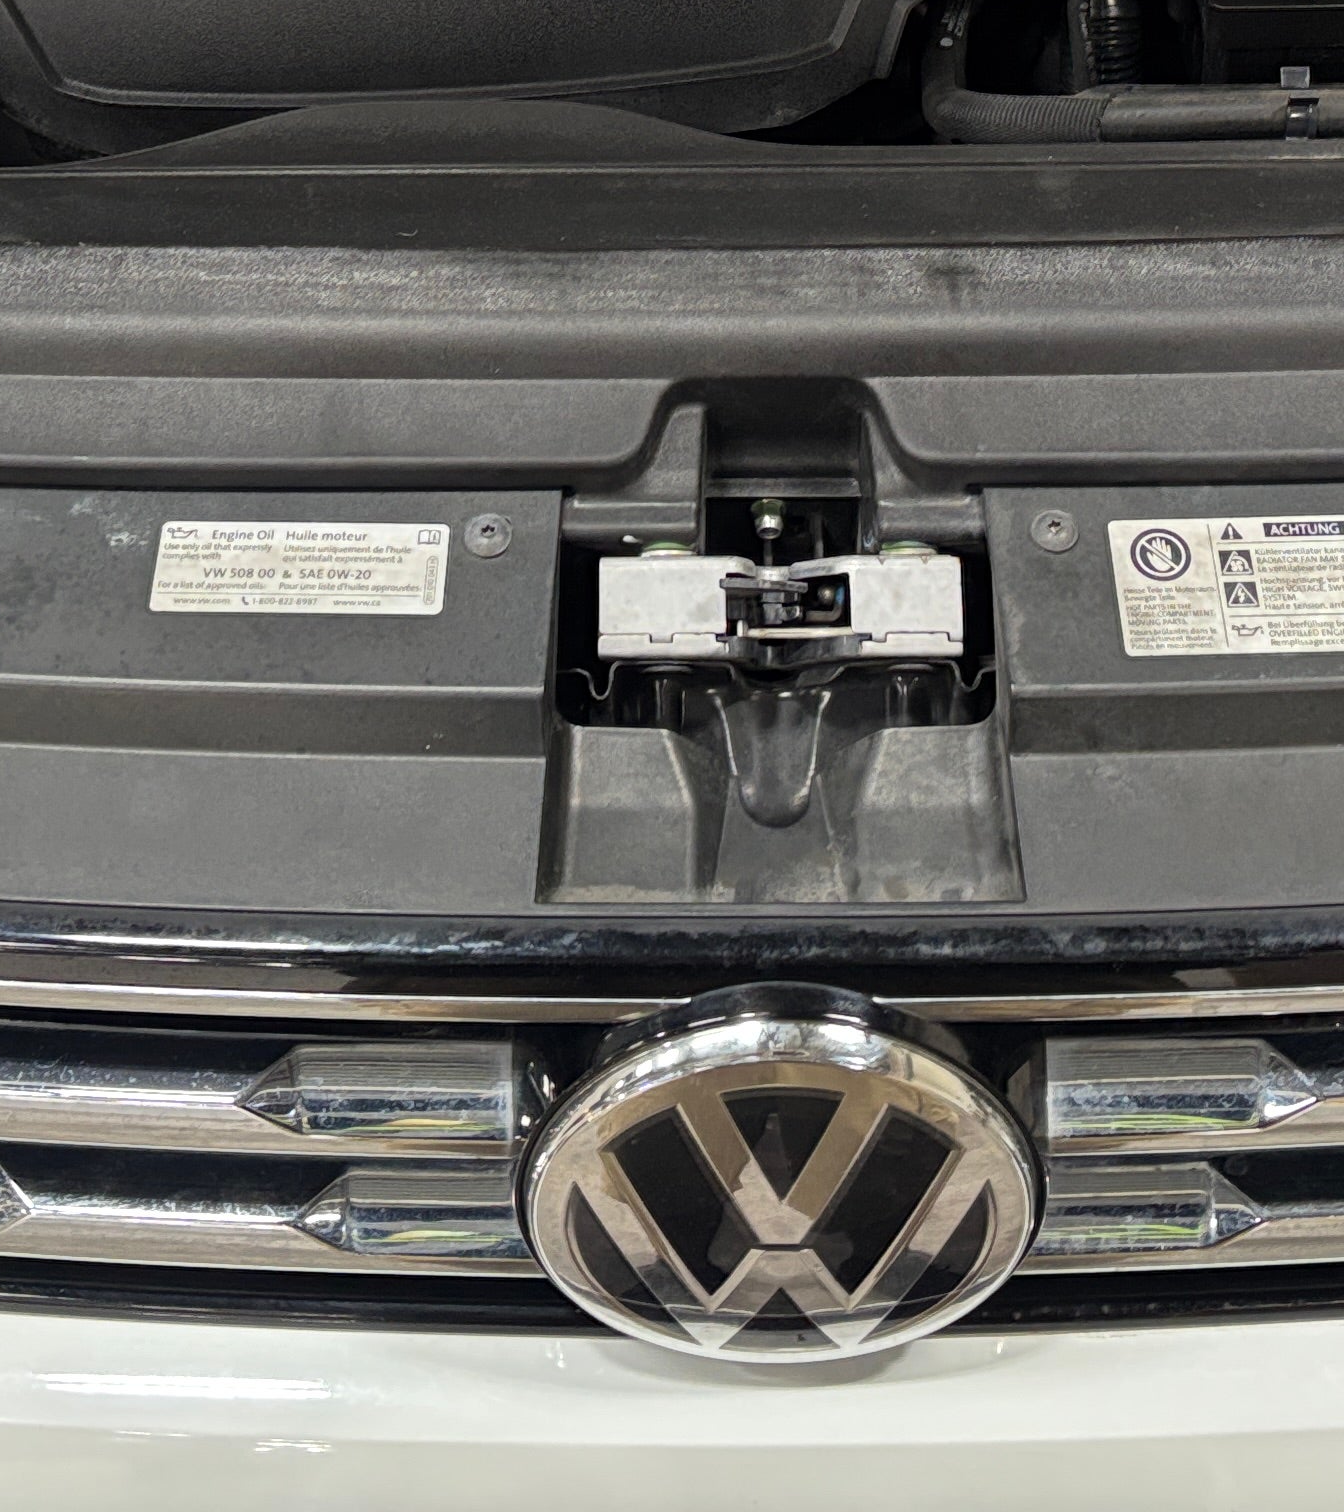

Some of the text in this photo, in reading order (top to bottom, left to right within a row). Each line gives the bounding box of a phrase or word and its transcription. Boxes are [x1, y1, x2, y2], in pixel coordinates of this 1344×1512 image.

[1269, 523, 1341, 536] ACHTUNG
[212, 530, 368, 542] Engine Oil Huile moteur
[181, 543, 199, 552] only
[214, 543, 232, 551] that
[233, 544, 272, 553] expressly
[318, 546, 371, 554] uniquement
[162, 553, 200, 561] complies
[282, 554, 297, 563] qui
[298, 554, 333, 562] satisfait
[334, 554, 396, 564] expressément
[1256, 556, 1298, 564] RADIATOR
[1300, 555, 1317, 563] FAN
[1319, 555, 1339, 563] MAY
[204, 568, 372, 580] VW 508 00 & SAE 0W-20
[1327, 576, 1340, 584] vor
[158, 581, 171, 589] For
[180, 581, 194, 589] list
[195, 581, 204, 589] of
[206, 582, 247, 591] approved
[279, 582, 298, 590] Pour
[318, 582, 335, 590] liste
[337, 582, 370, 591] d'huiles
[1262, 585, 1285, 593] HIGH
[1264, 602, 1290, 610] Haute
[1269, 629, 1320, 637] OVERFILLED
[1270, 638, 1323, 647] Remplissage
[523, 1007, 1039, 1362] VW
